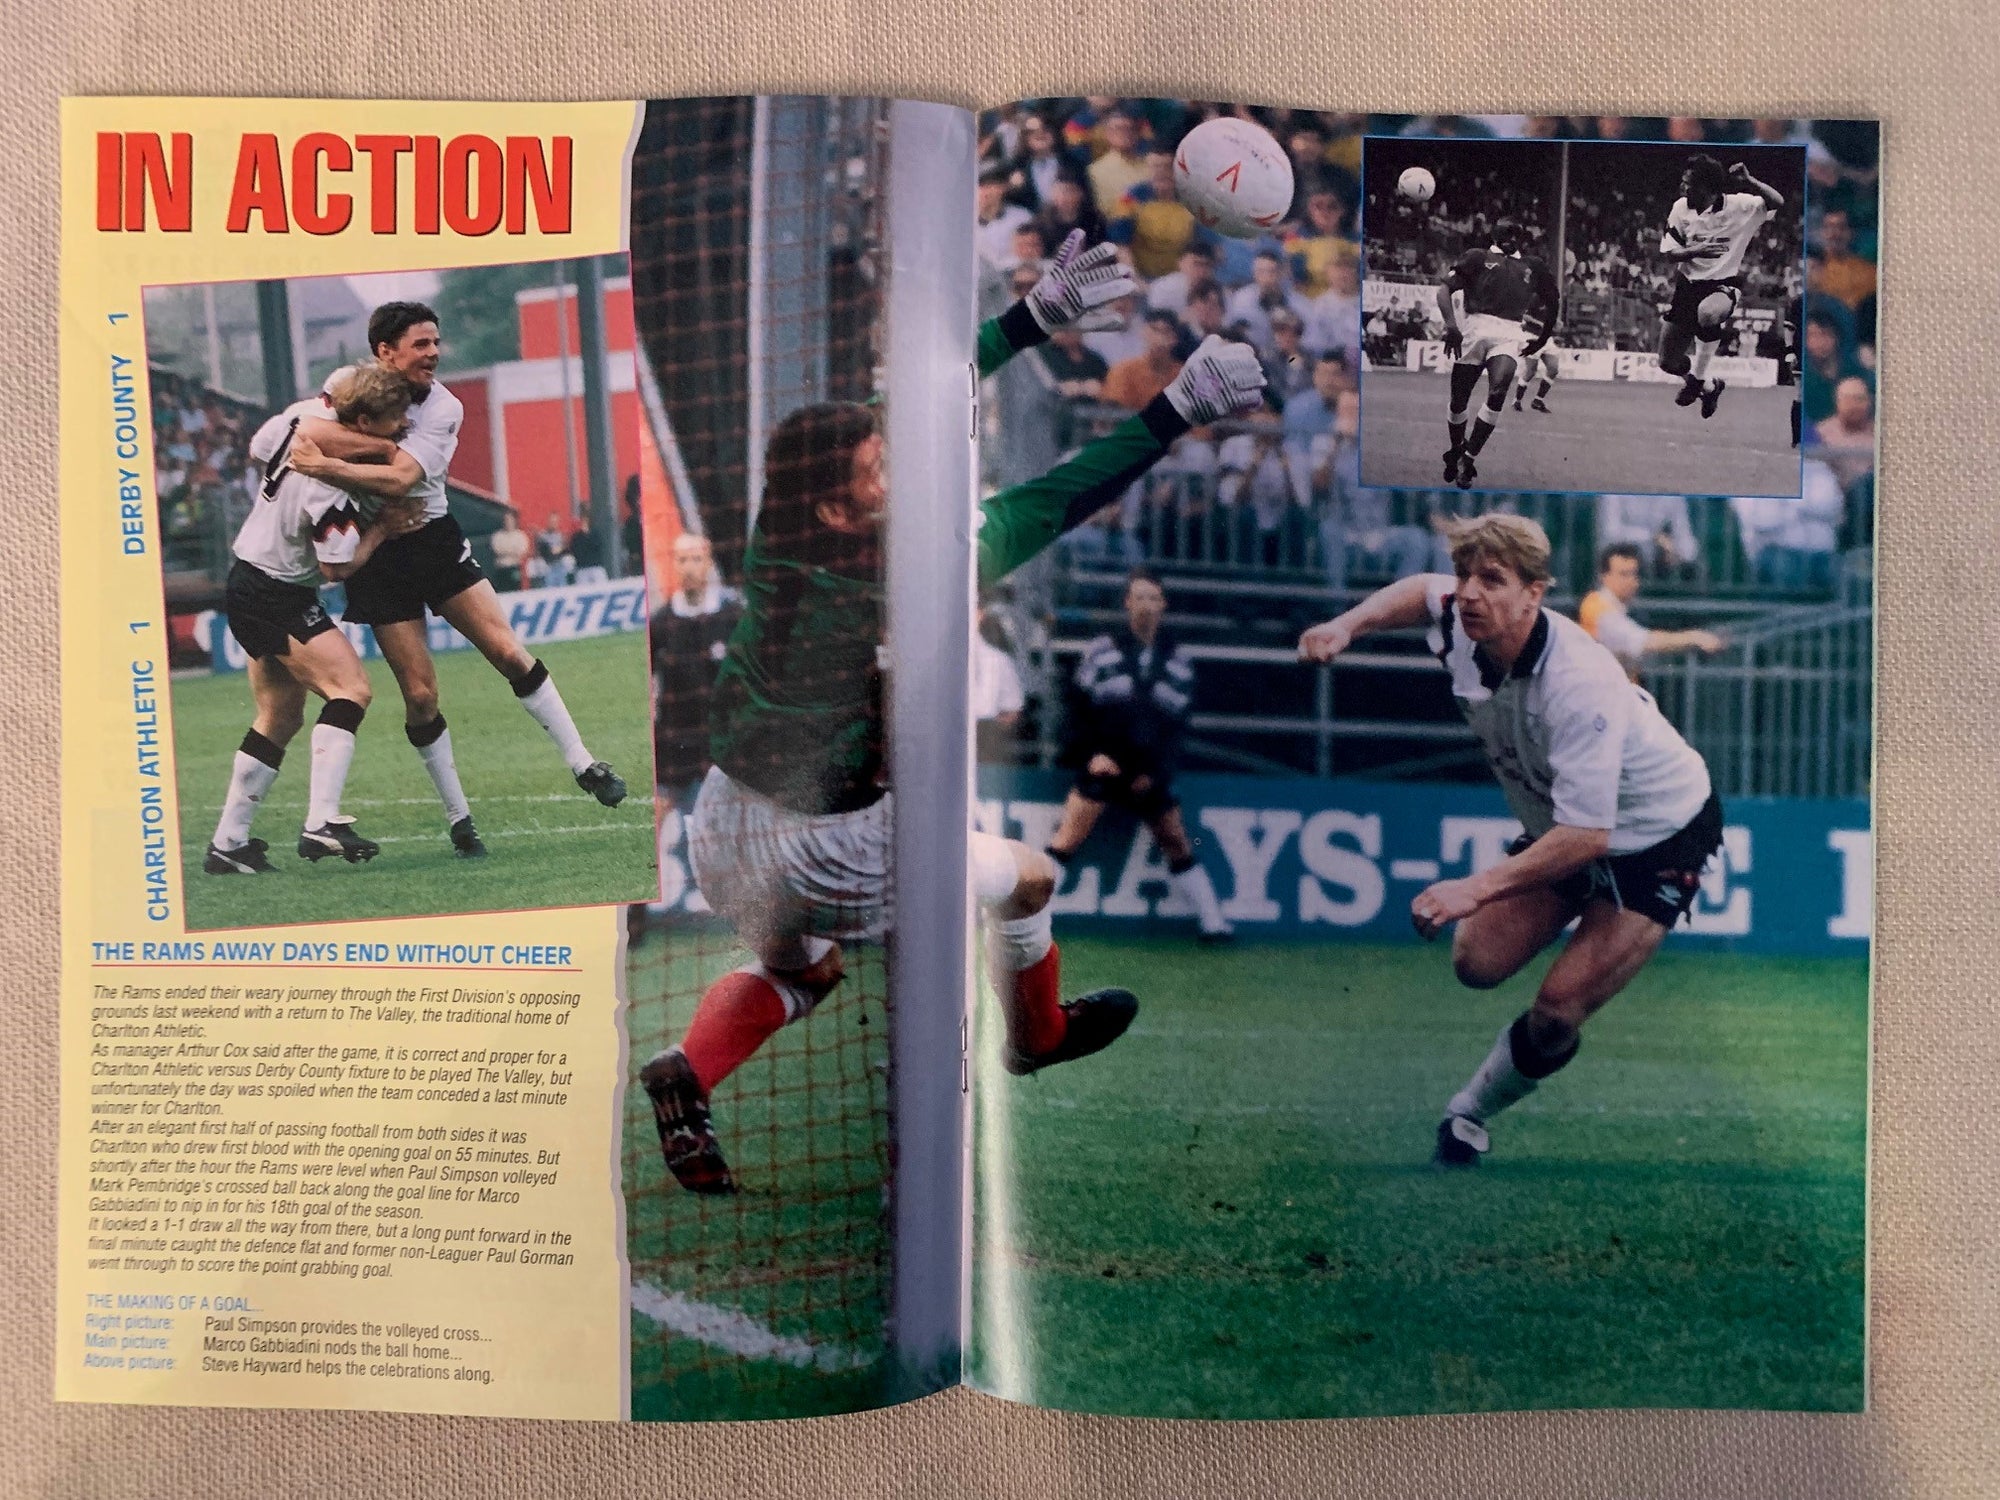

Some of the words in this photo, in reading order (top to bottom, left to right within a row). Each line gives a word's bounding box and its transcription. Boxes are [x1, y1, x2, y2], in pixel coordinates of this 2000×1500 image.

[97, 132, 193, 232] IN
[226, 132, 573, 236] ACTION
[109, 312, 129, 325] 1
[111, 354, 139, 460] COUNTY
[119, 467, 144, 555] DERBY
[130, 621, 151, 635] 1
[133, 660, 161, 777] ATHLETIC
[141, 786, 170, 921] CHARLTON
[92, 943, 135, 960] THE
[142, 943, 205, 960] RAMS
[212, 943, 275, 960] AWAY
[283, 943, 338, 960] DAYS
[345, 943, 390, 961] END
[396, 944, 494, 962] WITHOUT
[502, 945, 572, 963] CHEER
[93, 985, 118, 1000] The
[121, 985, 162, 1000] Rams
[164, 985, 207, 1000] ended
[209, 985, 241, 1000] their
[243, 989, 285, 1003] weary
[286, 985, 338, 1004] journey
[340, 986, 393, 1004] through
[395, 986, 417, 1002] the
[419, 986, 450, 1002] First
[451, 987, 516, 1004] Division's
[519, 988, 581, 1008] opposing
[91, 1003, 149, 1021] grounds
[152, 1004, 179, 1018] last
[180, 1004, 241, 1019] weekend
[243, 1004, 273, 1019] with
[274, 1008, 284, 1019] a
[287, 1005, 328, 1020] return
[330, 1006, 345, 1020] to
[351, 1005, 373, 1020] The
[374, 1006, 417, 1024] Valley,
[421, 1006, 443, 1022] the
[445, 1007, 512, 1023] traditional
[514, 1008, 553, 1024] home
[555, 1010, 571, 1025] of
[91, 1042, 110, 1058] As
[112, 1046, 174, 1060] manager
[176, 1042, 220, 1057] Arthur
[222, 1042, 250, 1057] Cox
[252, 1042, 281, 1058] said
[283, 1043, 315, 1058] after
[317, 1043, 339, 1058] the
[340, 1047, 380, 1062] game,
[384, 1044, 395, 1060] it
[397, 1045, 409, 1060] is
[411, 1046, 460, 1061] correct
[461, 1047, 487, 1062] and
[488, 1051, 534, 1067] proper
[536, 1049, 556, 1065] for
[558, 1054, 568, 1066] a
[91, 1062, 149, 1077] Charlton
[152, 1062, 204, 1076] Athletic
[207, 1065, 252, 1077] versus
[255, 1062, 296, 1080] Derby
[298, 1062, 346, 1081] County
[348, 1063, 390, 1079] fixture
[392, 1065, 407, 1080] to
[409, 1065, 426, 1080] be
[428, 1065, 473, 1084] played
[478, 1067, 500, 1083] The
[502, 1068, 545, 1087] Valley,
[550, 1070, 574, 1086] but
[91, 1099, 138, 1116] winner
[140, 1099, 161, 1115] for
[164, 1098, 224, 1115] Charlton.
[90, 1119, 124, 1135] After
[126, 1123, 144, 1135] an
[146, 1119, 197, 1138] elegant
[199, 1119, 228, 1135] first
[230, 1120, 256, 1136] half
[258, 1120, 274, 1136] of
[274, 1120, 328, 1140] passing
[330, 1121, 380, 1138] football
[381, 1122, 414, 1139] from
[417, 1124, 448, 1140] both
[450, 1125, 486, 1142] sides
[488, 1126, 499, 1142] it
[500, 1130, 528, 1143] was
[90, 1158, 137, 1176] shortly
[139, 1158, 172, 1173] after
[174, 1158, 197, 1174] the
[199, 1158, 232, 1174] hour
[234, 1159, 256, 1174] the
[259, 1159, 298, 1175] Rams
[301, 1164, 334, 1176] were
[336, 1161, 367, 1177] level
[369, 1162, 405, 1178] when
[408, 1163, 438, 1179] Paul
[439, 1164, 499, 1185] Simpson
[501, 1167, 558, 1188] volleyed
[89, 1216, 100, 1231] It
[101, 1216, 148, 1232] looked
[150, 1220, 159, 1232] a
[163, 1216, 185, 1232] 1-1
[189, 1217, 224, 1232] draw
[225, 1217, 243, 1233] all
[244, 1218, 267, 1233] the
[269, 1222, 297, 1237] way
[299, 1219, 332, 1235] from
[334, 1220, 370, 1238] there,
[375, 1222, 399, 1238] but
[400, 1226, 409, 1238] a
[411, 1223, 442, 1242] long
[443, 1225, 476, 1244] punt
[477, 1226, 531, 1244] forward
[533, 1229, 547, 1245] in
[549, 1230, 573, 1246] the
[87, 1256, 121, 1271] went
[123, 1255, 178, 1274] through
[179, 1257, 195, 1272] to
[197, 1260, 235, 1272] score
[237, 1256, 260, 1272] the
[262, 1257, 299, 1276] point
[299, 1257, 360, 1278] grabbing
[361, 1259, 393, 1279] goal.
[88, 1293, 113, 1308] THE
[118, 1294, 174, 1309] MAKING
[178, 1295, 196, 1310] OF
[200, 1296, 209, 1310] A
[87, 1313, 121, 1331] Right
[125, 1313, 175, 1332] picture:
[204, 1315, 234, 1331] Paul
[238, 1316, 297, 1336] Simpson
[301, 1318, 358, 1338] provides
[362, 1320, 382, 1336] the
[386, 1321, 439, 1342] volleyed
[443, 1328, 492, 1342] cross...
[86, 1334, 116, 1350] Main
[122, 1333, 170, 1352] picture:
[203, 1335, 246, 1352] Marco
[250, 1337, 320, 1354] Gabbiadini
[325, 1339, 357, 1355] nods
[361, 1340, 381, 1356] the
[386, 1341, 408, 1357] ball
[413, 1342, 462, 1360] home...
[84, 1353, 124, 1369] Above
[128, 1353, 177, 1372] picture:
[202, 1355, 239, 1372] Steve
[243, 1356, 302, 1376] Hayward
[306, 1358, 342, 1378] helps
[346, 1360, 366, 1376] the
[370, 1360, 450, 1380] celebrations
[454, 1364, 495, 1385] along.
